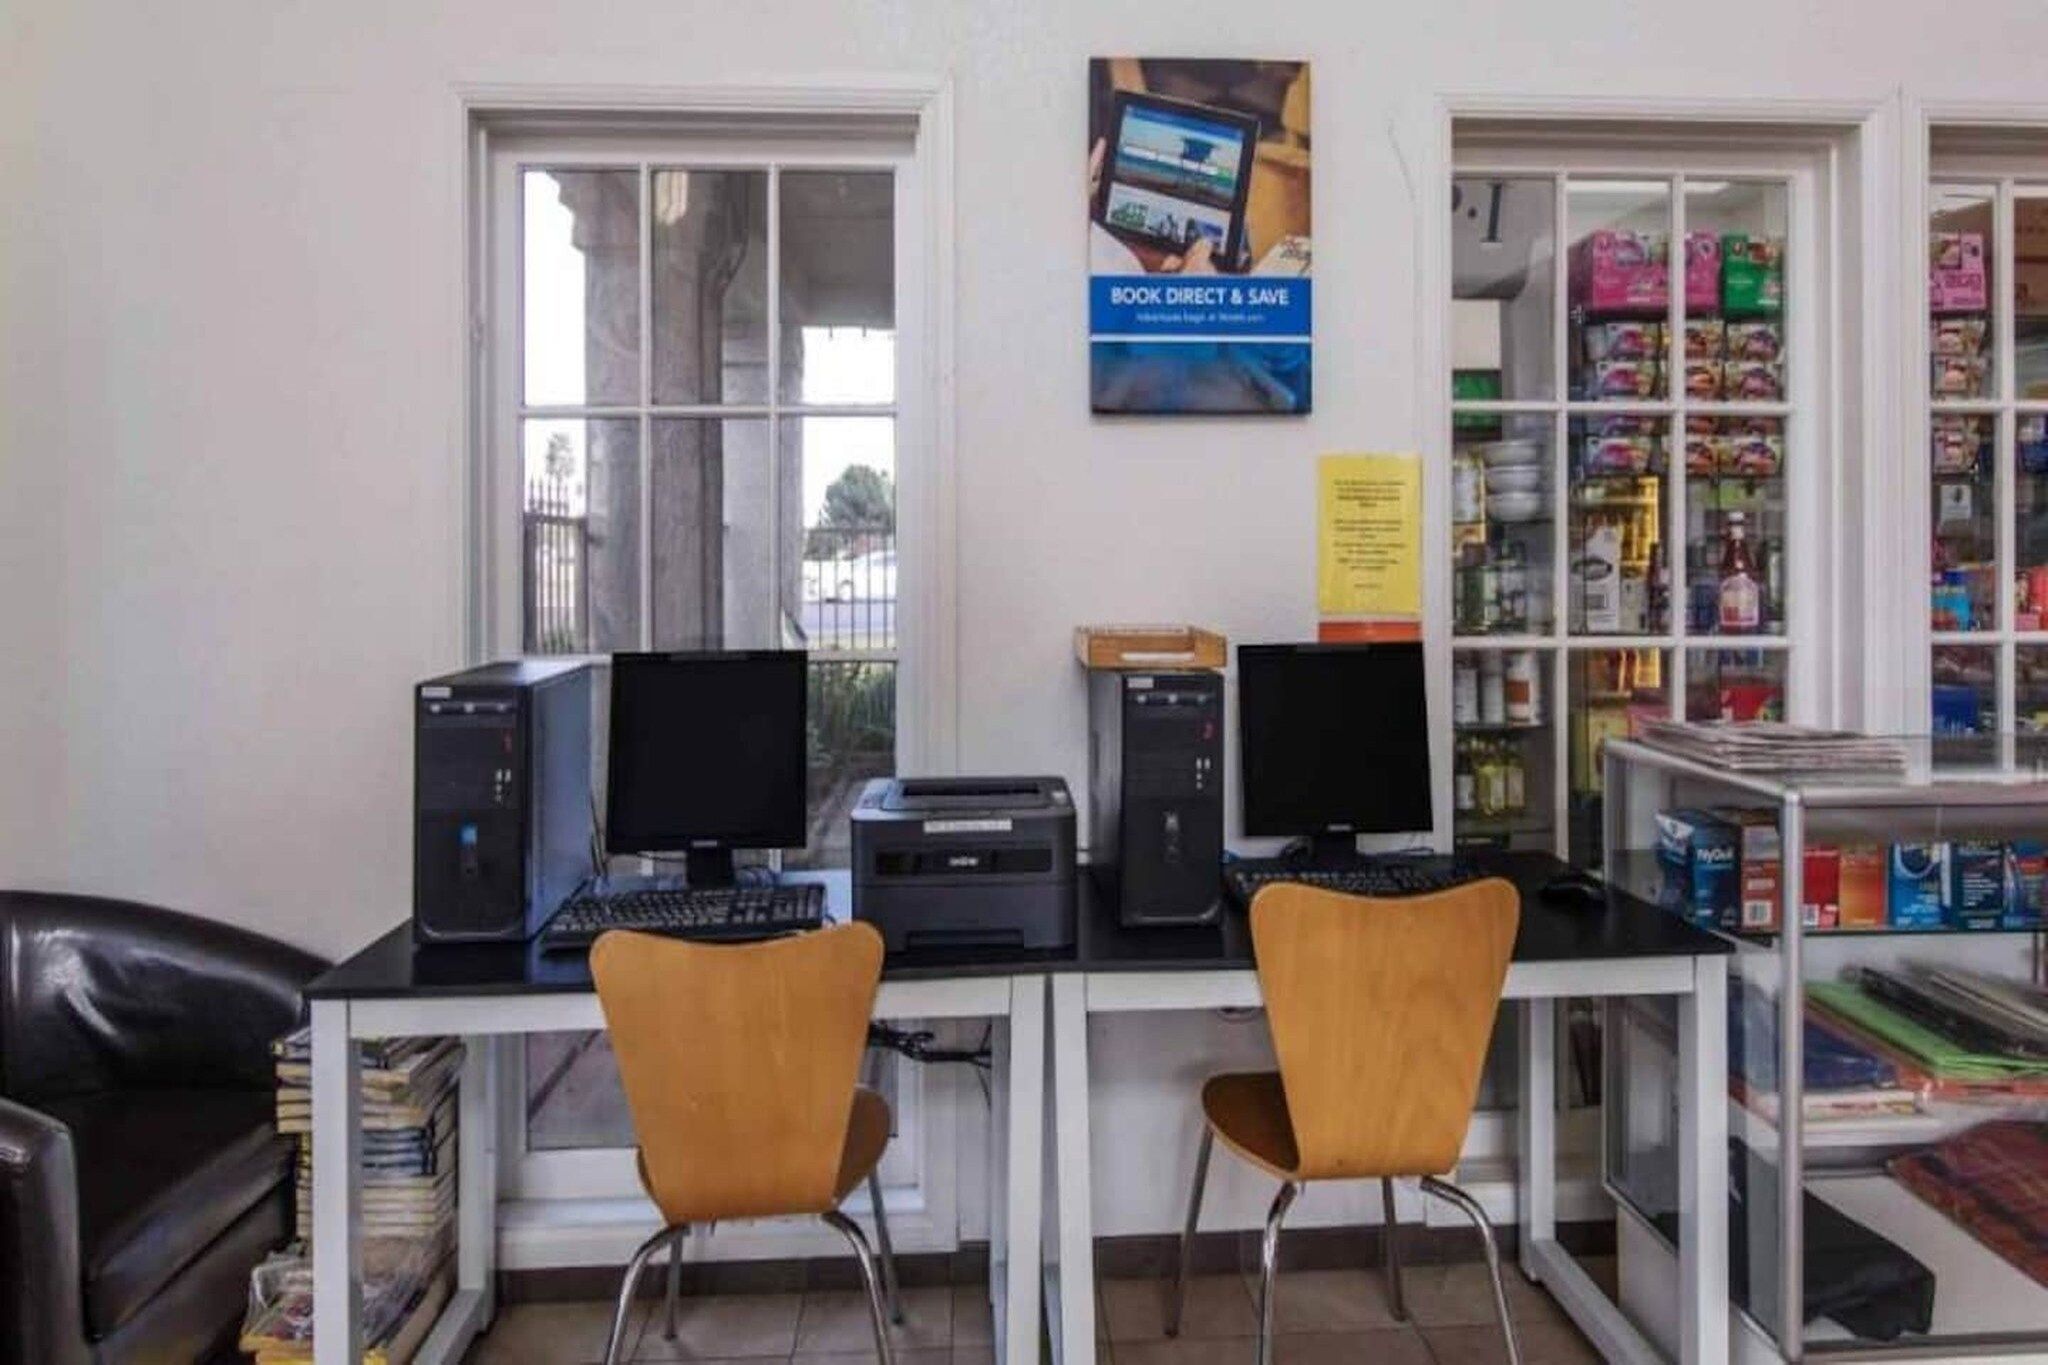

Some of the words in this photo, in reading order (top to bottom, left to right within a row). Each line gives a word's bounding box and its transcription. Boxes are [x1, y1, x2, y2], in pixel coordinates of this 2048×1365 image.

[1111, 287, 1161, 305] BOOK
[1166, 287, 1225, 305] DIRECT
[1230, 287, 1243, 305] &
[1248, 287, 1290, 306] SAVE
